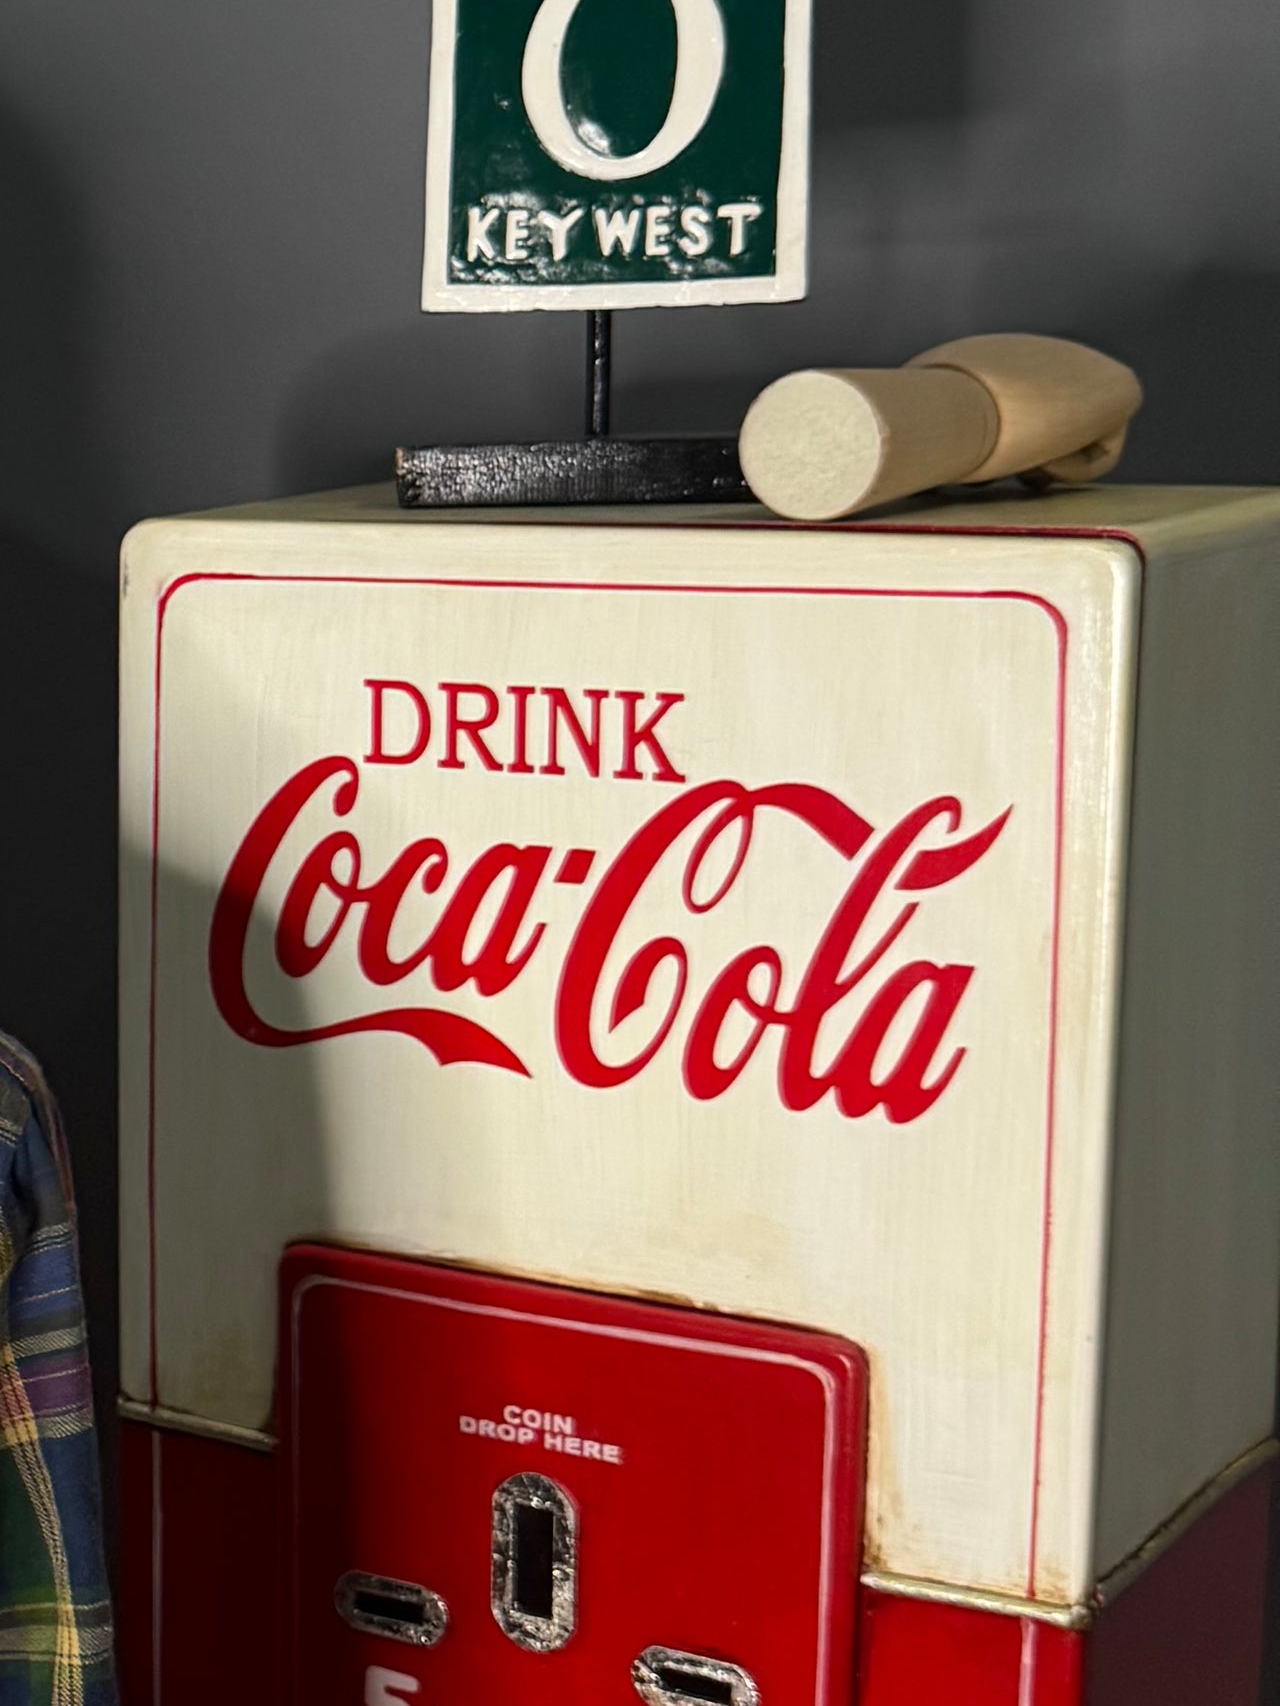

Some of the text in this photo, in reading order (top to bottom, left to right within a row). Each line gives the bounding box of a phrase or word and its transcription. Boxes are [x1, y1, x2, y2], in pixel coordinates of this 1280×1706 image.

[465, 202, 764, 264] KEY WEST
[362, 678, 687, 784] DRINK
[207, 754, 1014, 1125] Coca-Cola
[458, 1414, 625, 1465] DROP HERE
[502, 1403, 576, 1436] COIN
